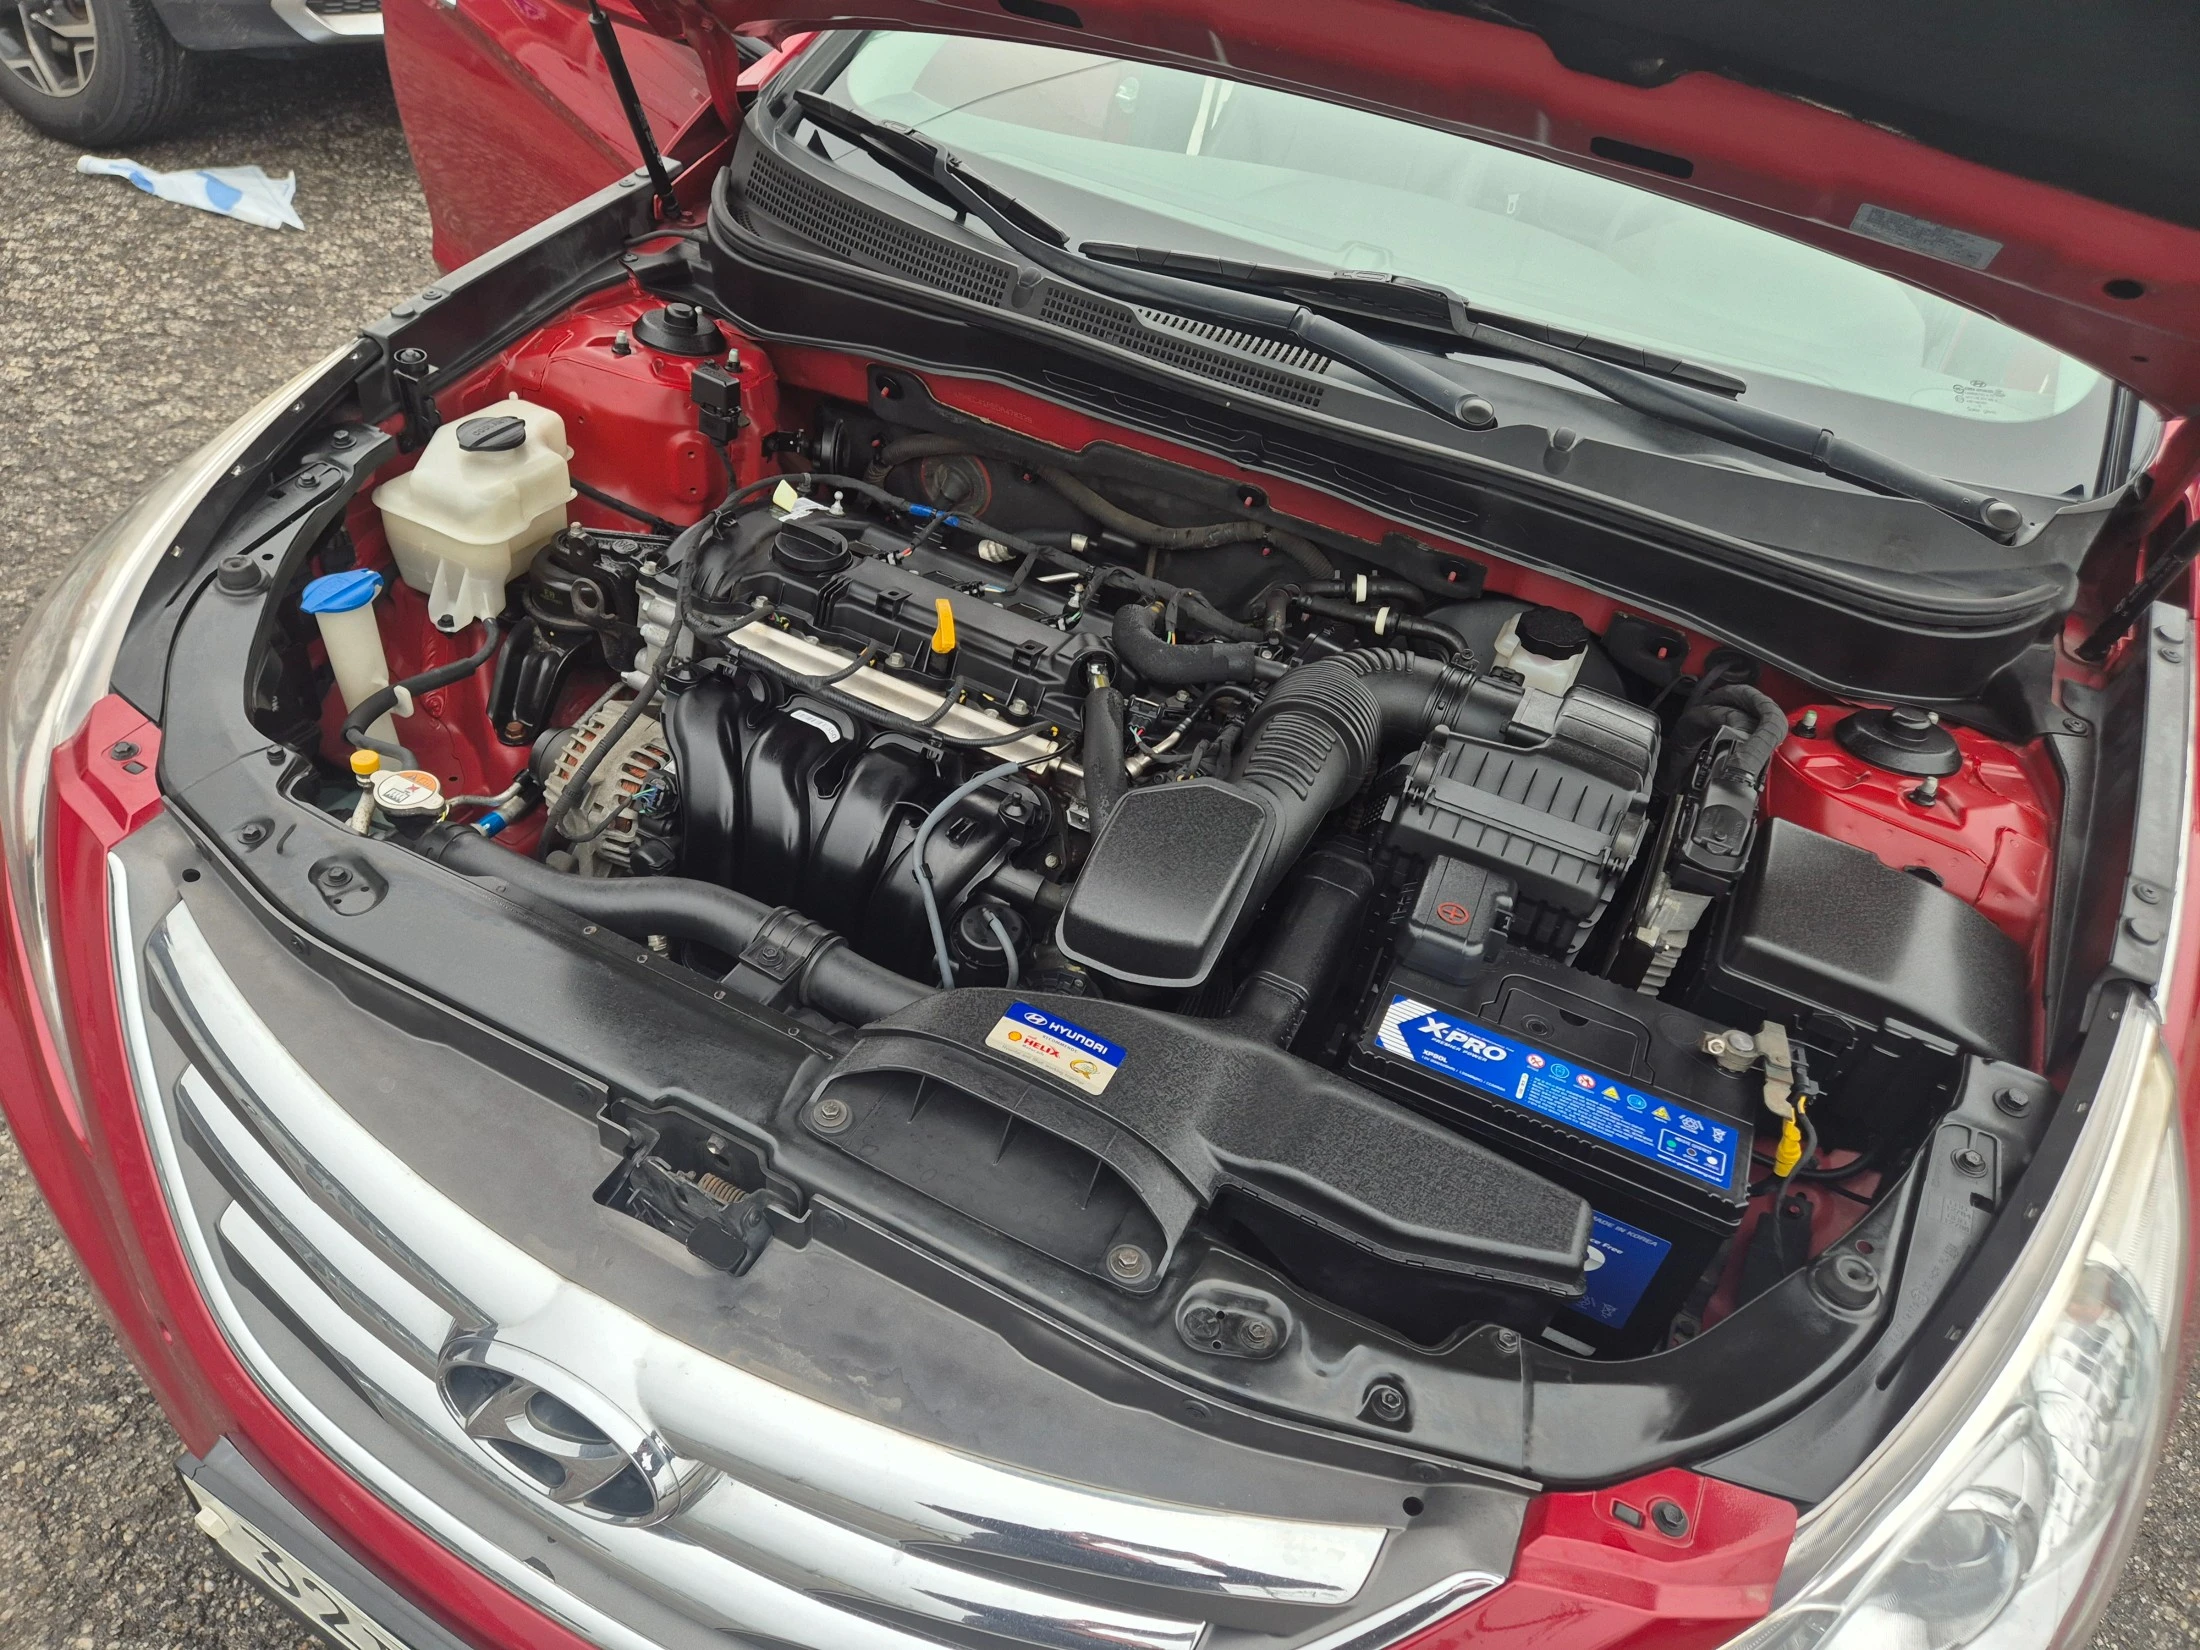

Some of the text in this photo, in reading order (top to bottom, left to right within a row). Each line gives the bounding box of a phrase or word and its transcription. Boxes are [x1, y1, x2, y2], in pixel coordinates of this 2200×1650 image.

[1024, 1038, 1060, 1058] HELIX
[1049, 1022, 1108, 1055] HYUNDAI
[1418, 1016, 1507, 1062] X-PRO
[1431, 1037, 1462, 1054] PREMIER
[1462, 1047, 1488, 1062] POWER
[1602, 1242, 1624, 1255] Free
[1615, 1226, 1626, 1234] IN
[1627, 1231, 1658, 1247] KOREA
[241, 1525, 392, 1650] 32
